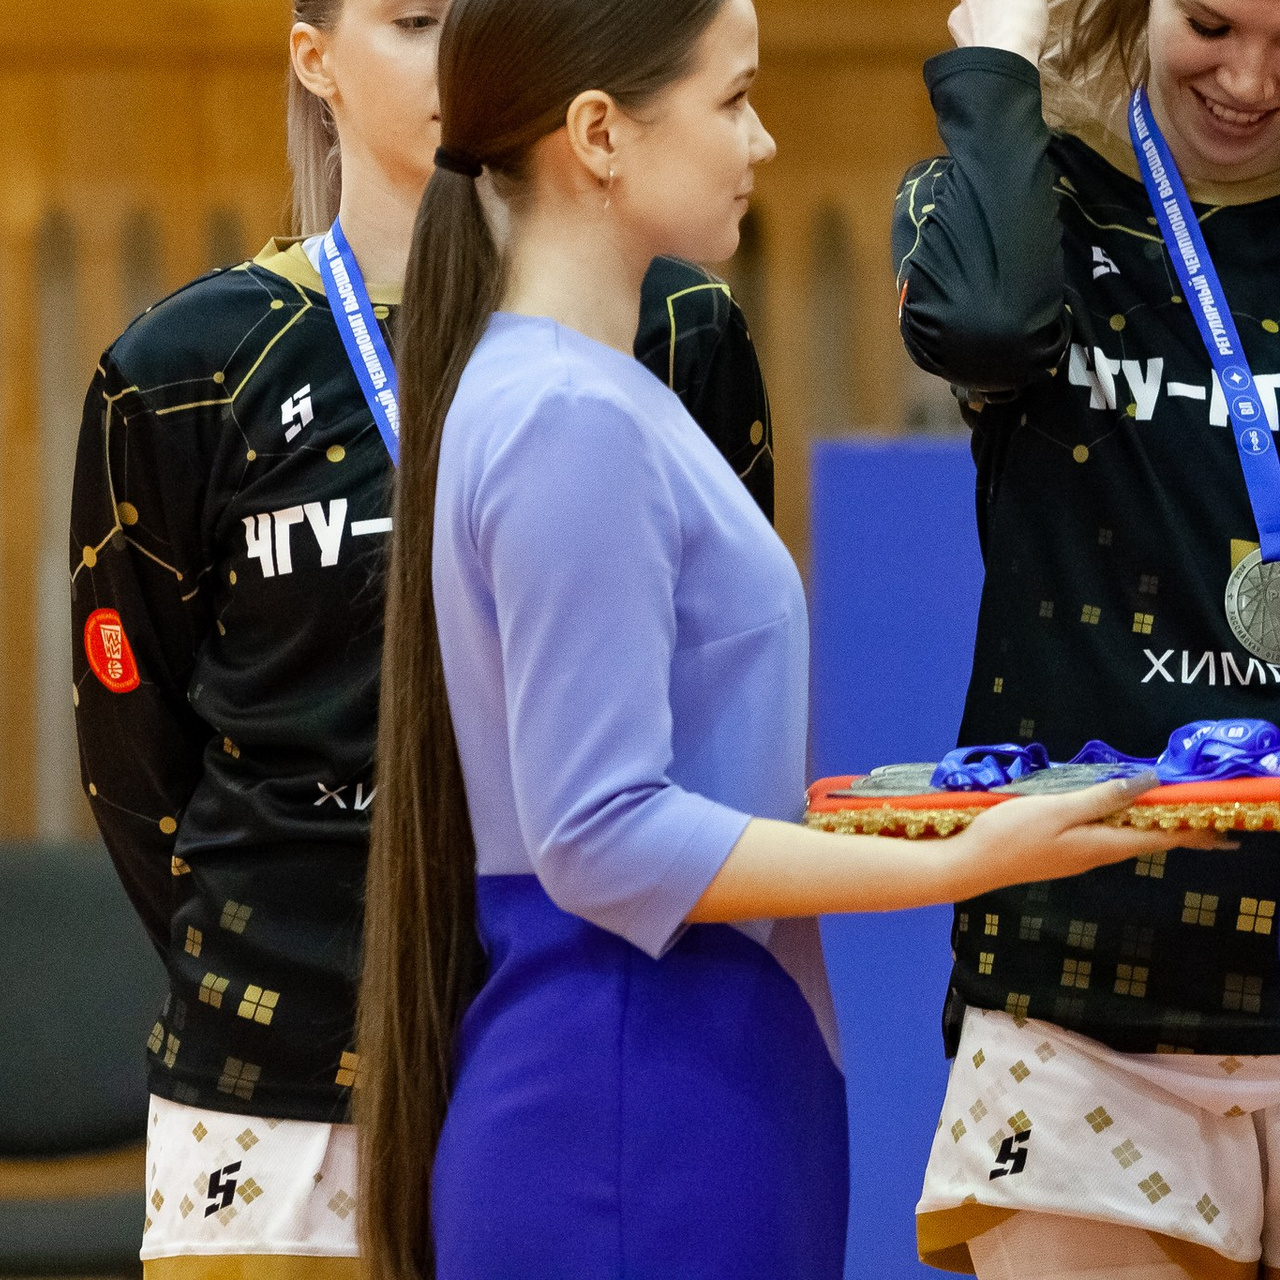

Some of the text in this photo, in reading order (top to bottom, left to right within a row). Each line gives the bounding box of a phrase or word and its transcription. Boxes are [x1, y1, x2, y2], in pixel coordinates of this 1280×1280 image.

[1142, 137, 1174, 199] ВЫСШАЯ
[1163, 198, 1201, 275] ЧЕМПИОНАТ
[347, 311, 388, 390] ЧЕМПИОНАТ
[1188, 274, 1234, 356] РЕГУЛЯРНЫЙ
